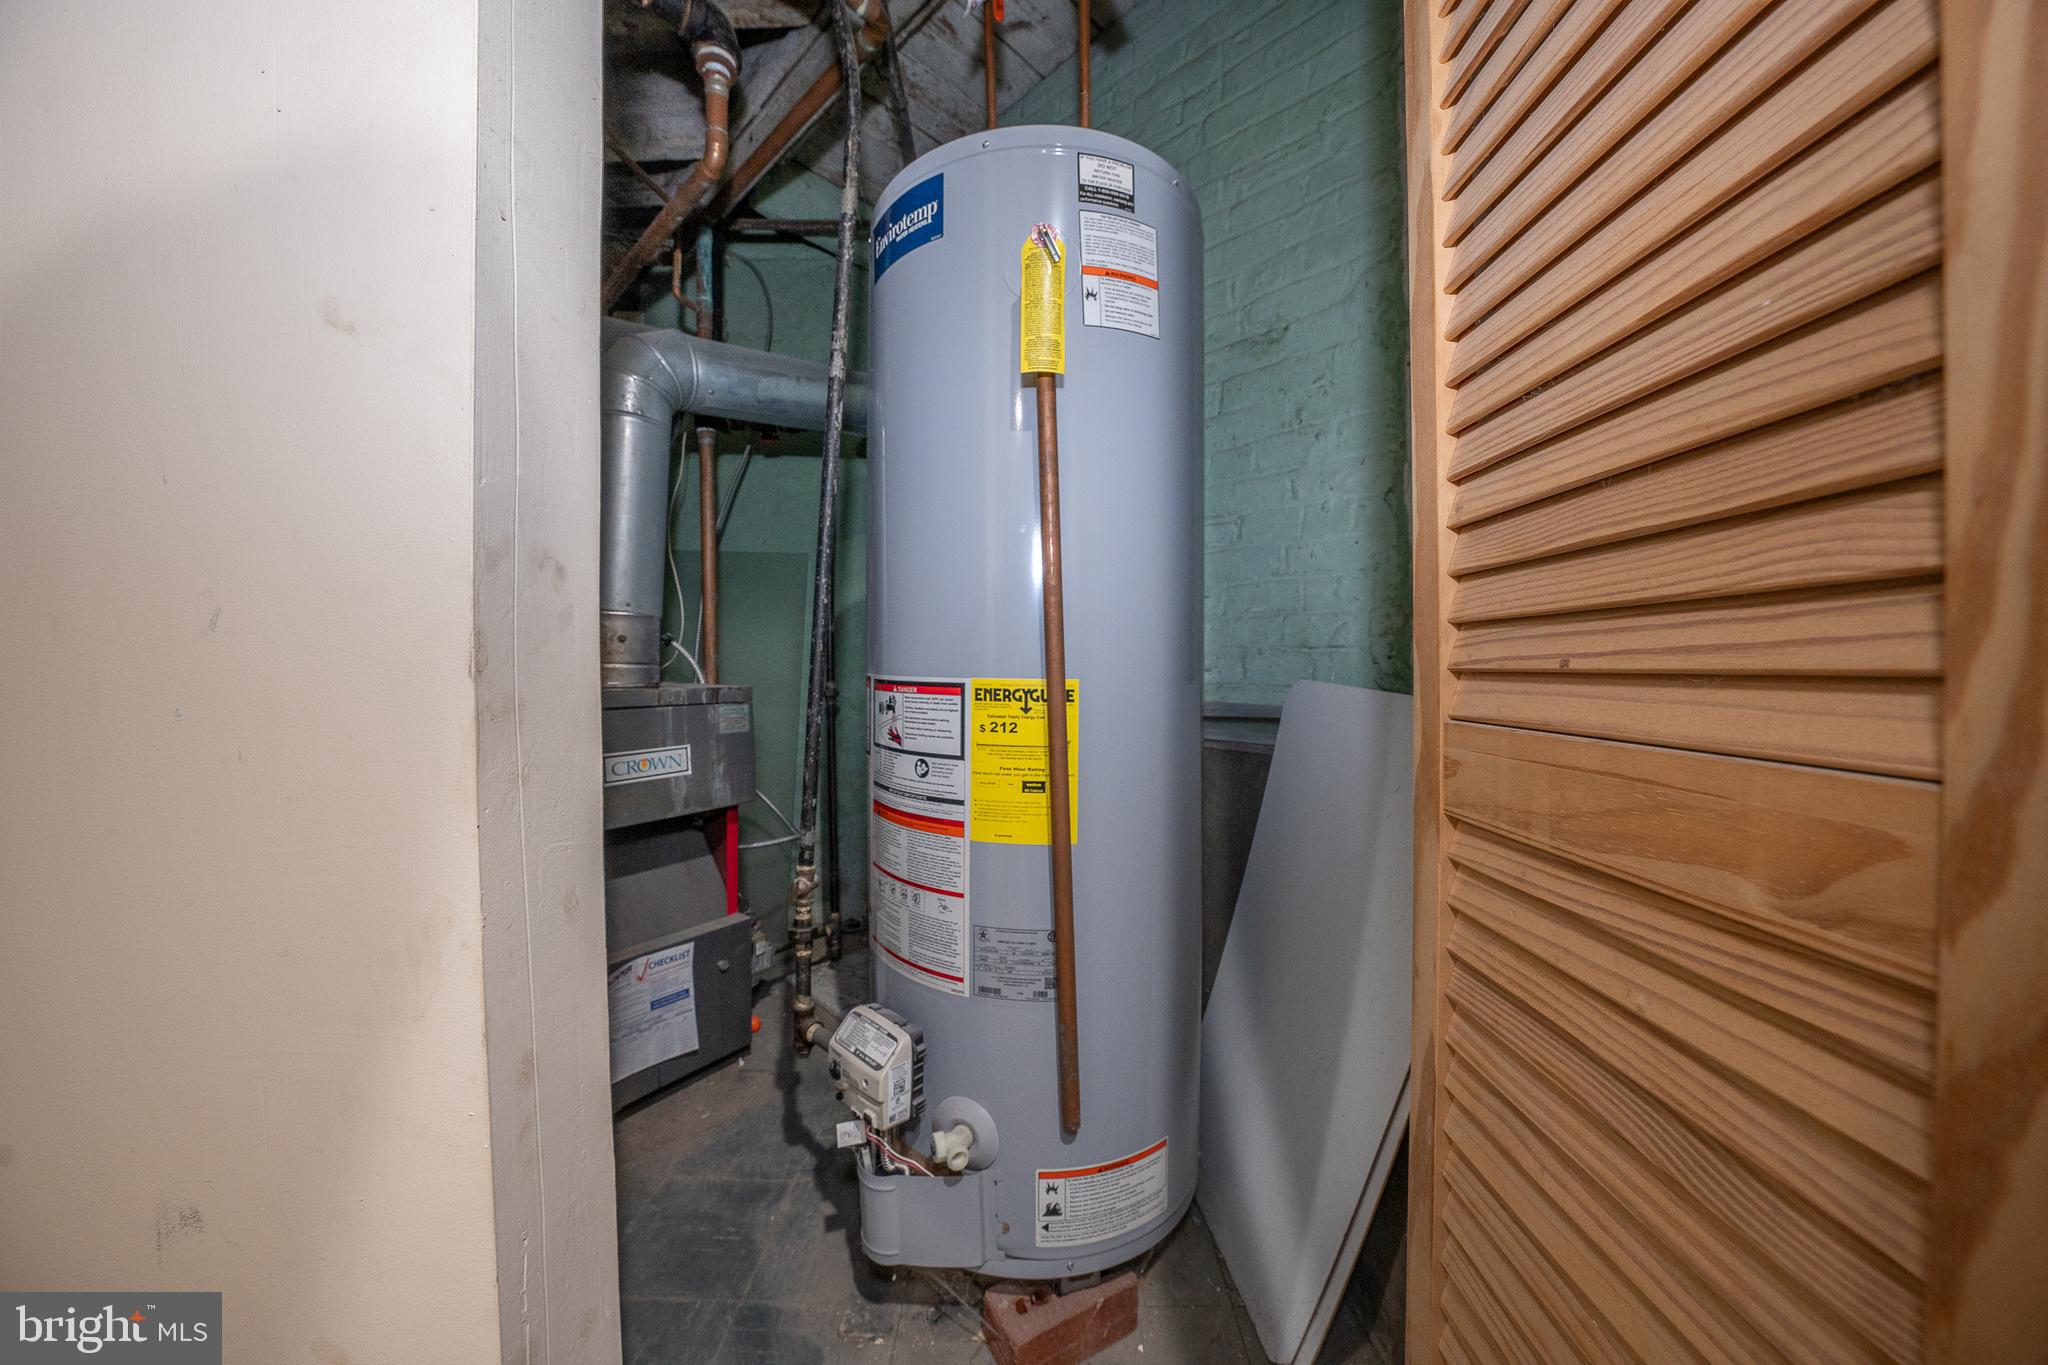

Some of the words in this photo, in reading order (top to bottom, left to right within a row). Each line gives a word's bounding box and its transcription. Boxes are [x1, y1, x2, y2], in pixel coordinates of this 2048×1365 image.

[875, 201, 938, 259] Envirotemp
[989, 722, 1018, 734] 212
[611, 754, 683, 776] CROWN
[648, 949, 691, 970] CHECKLIST
